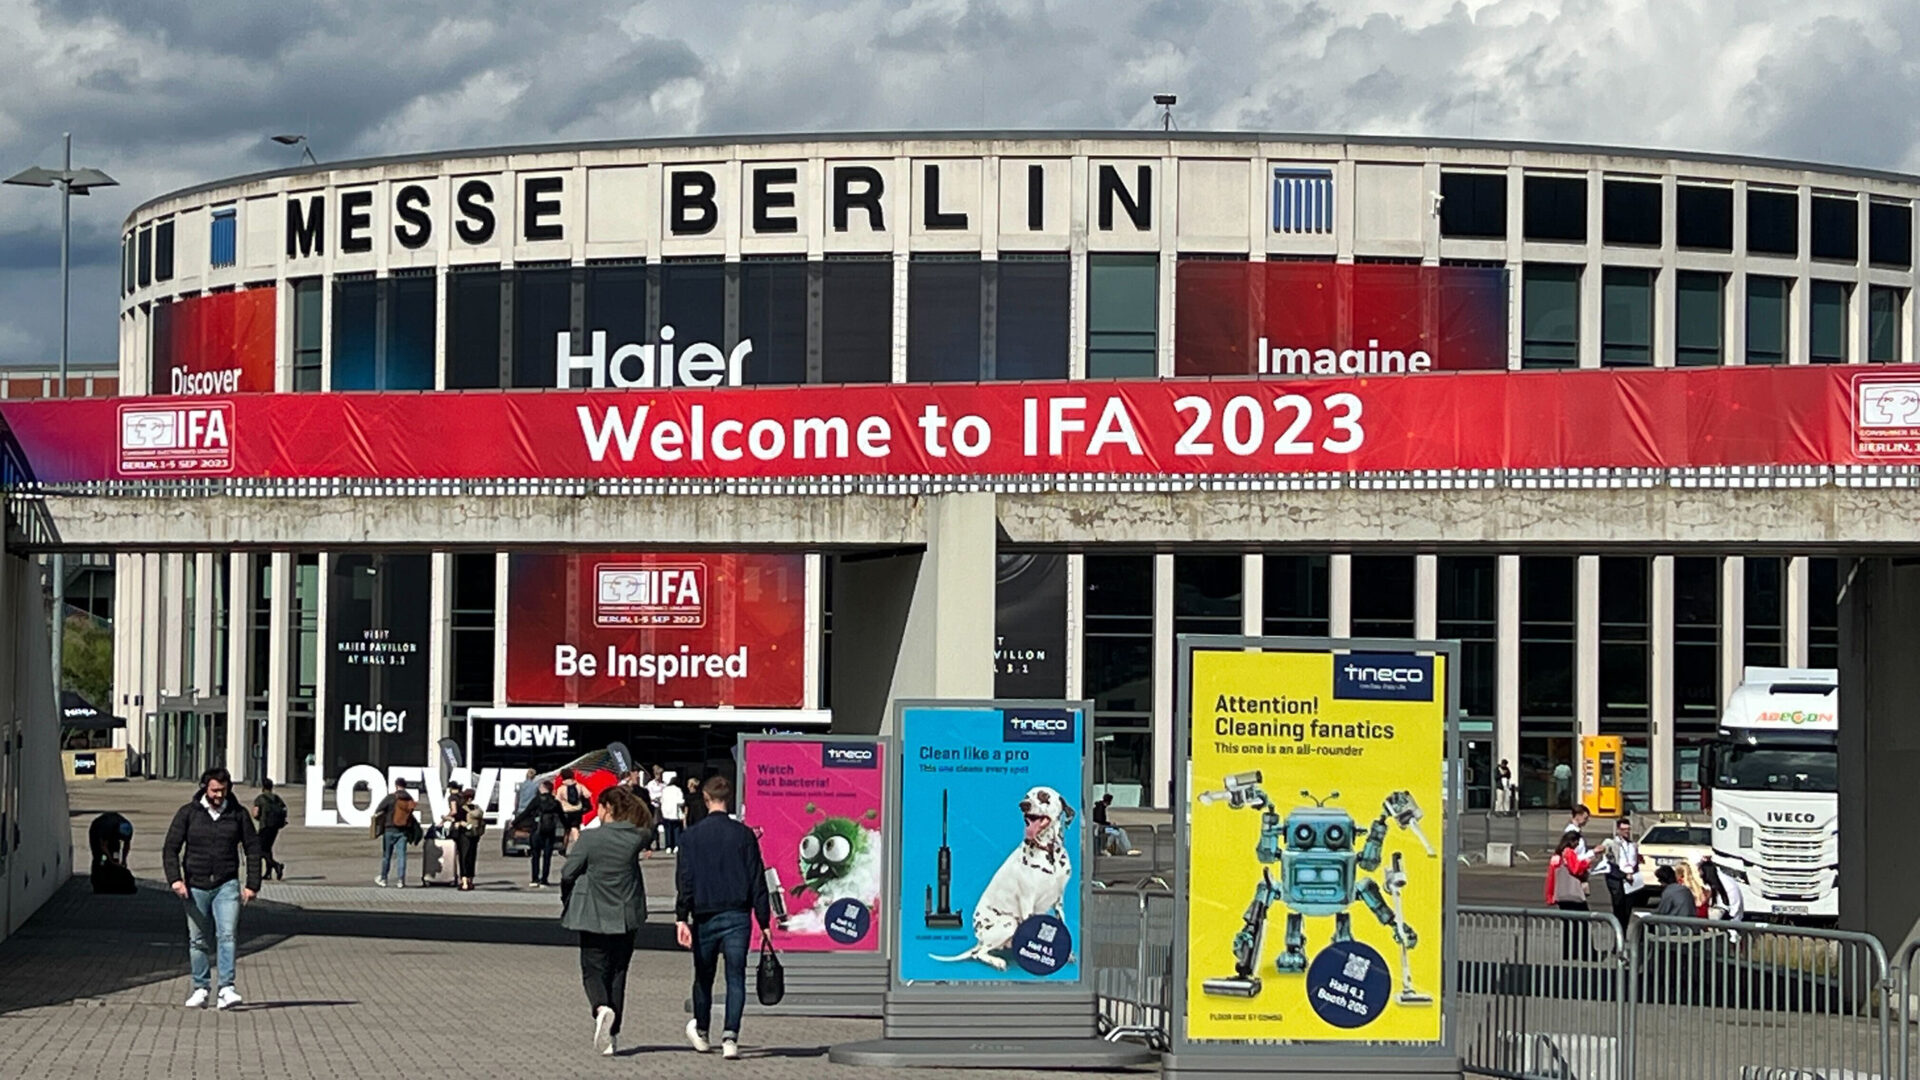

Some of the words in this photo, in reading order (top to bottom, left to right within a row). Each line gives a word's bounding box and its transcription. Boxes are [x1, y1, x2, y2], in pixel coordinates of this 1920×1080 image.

[286, 175, 564, 259] MESSE
[670, 164, 1153, 236] BERLIN
[556, 325, 753, 388] Haier
[1258, 337, 1431, 374] Imagine
[171, 366, 242, 395] Discover
[177, 409, 229, 448] IFA
[576, 404, 891, 462] Welcome
[918, 404, 991, 458] to
[1023, 396, 1144, 457] IFA
[1173, 392, 1366, 457] 2023
[178, 459, 198, 469] SEP
[200, 458, 229, 468] 2023
[650, 570, 700, 605] IFA
[651, 615, 670, 624] SEP
[672, 615, 701, 624] 2023
[363, 629, 390, 640] VISIT
[338, 642, 366, 652] HAIER
[369, 642, 417, 653] PAVILLON
[994, 650, 1046, 660] VILLON
[347, 654, 359, 664] AT
[362, 655, 385, 665] HALL
[555, 644, 597, 676] Be
[607, 644, 748, 685] Inspired
[1343, 663, 1424, 683] tineco
[1215, 694, 1319, 715] Attention!
[344, 704, 407, 733] Haier
[1010, 716, 1068, 730] tineco
[494, 723, 576, 747] LOEWE.
[1215, 717, 1305, 742] Cleaning
[1310, 718, 1395, 740] fanatics
[827, 748, 873, 760] tineco
[919, 746, 961, 761] Clean
[963, 746, 991, 761] like
[992, 749, 1001, 761] a
[1004, 749, 1030, 764] pro
[1214, 741, 1239, 754] This
[1241, 744, 1264, 755] one
[1266, 743, 1277, 755] is
[1279, 745, 1294, 755] an
[1296, 743, 1364, 757] all-rounder
[757, 764, 794, 775] Watch
[757, 777, 776, 787] out
[779, 776, 830, 788] bacteria!
[1767, 811, 1816, 824] IVECO
[1329, 977, 1350, 994] Hall
[1349, 986, 1365, 1002] 4.1
[1317, 987, 1348, 1008] Booth
[1347, 999, 1369, 1016] 205
